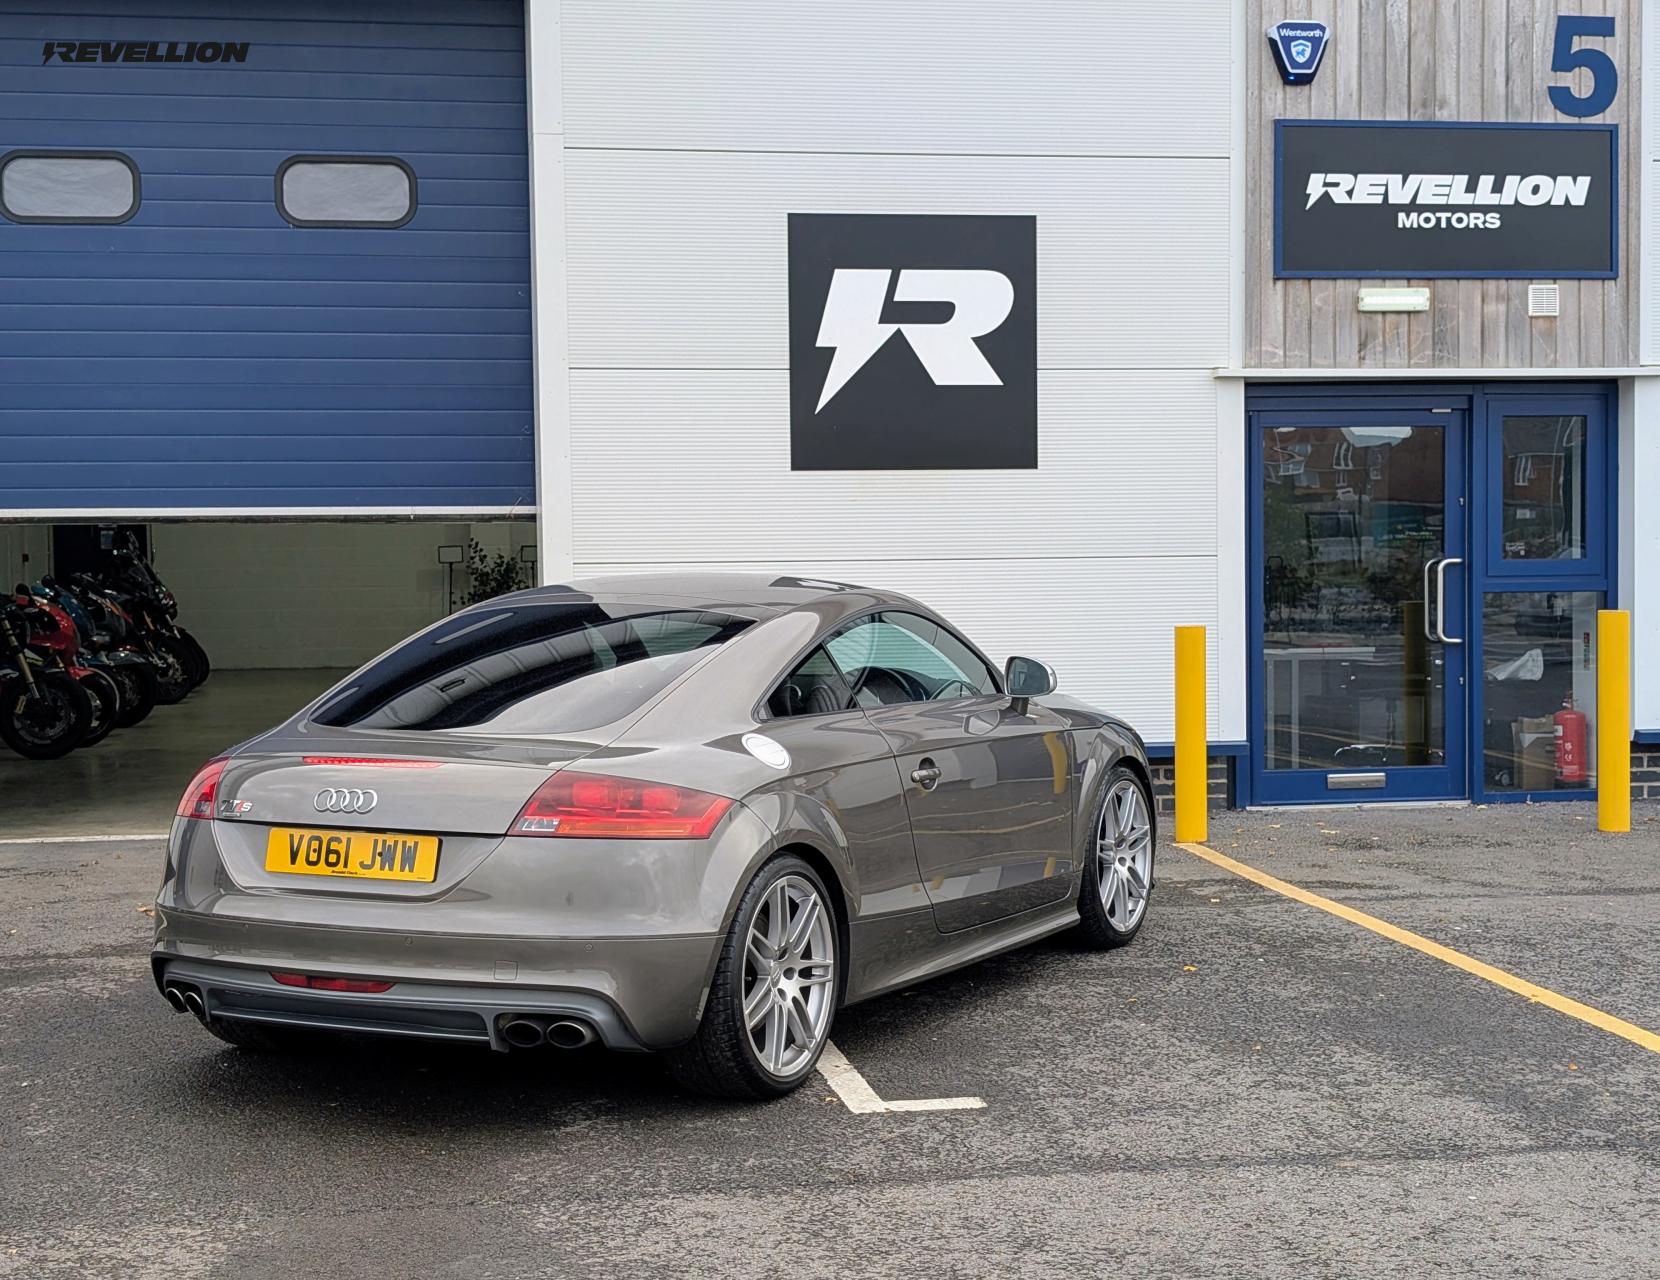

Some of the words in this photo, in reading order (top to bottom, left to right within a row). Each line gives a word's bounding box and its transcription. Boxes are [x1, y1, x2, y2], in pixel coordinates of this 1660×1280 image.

[1279, 28, 1323, 37] Wentworth
[1547, 15, 1618, 118] 5
[1305, 173, 1591, 211] REVELLION
[1397, 212, 1501, 229] MOTORS
[358, 838, 420, 873] JWW
